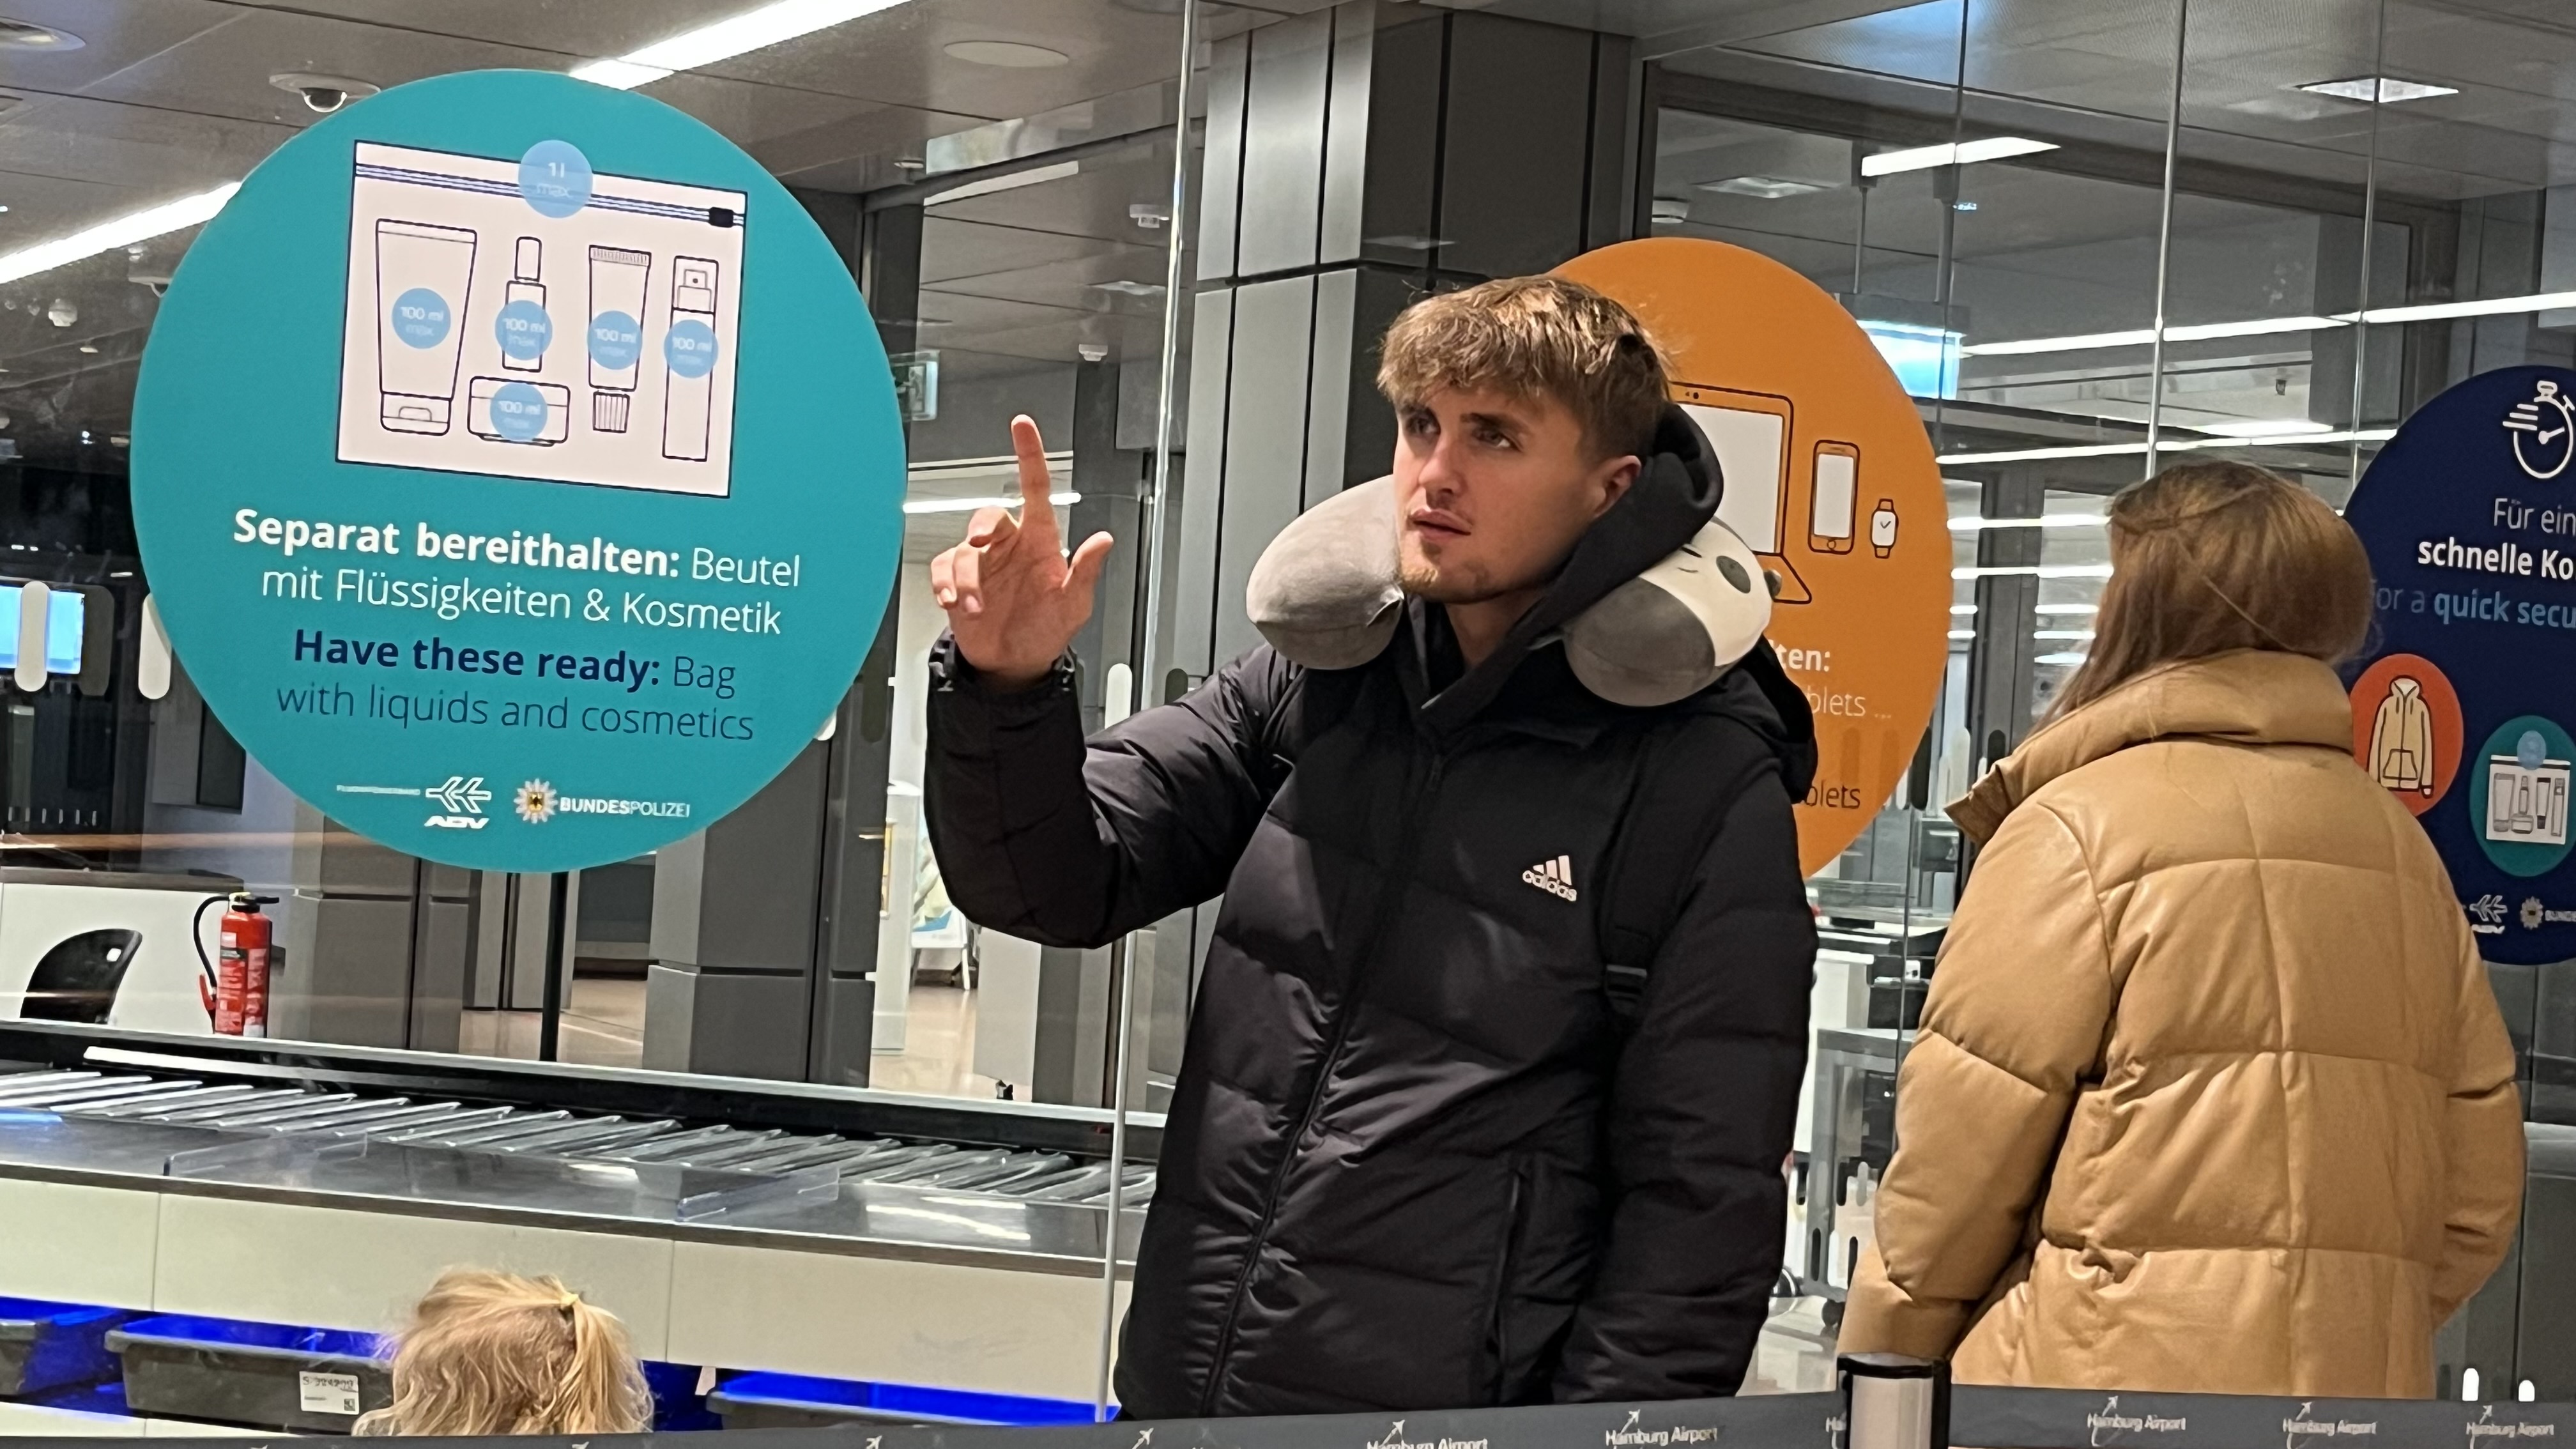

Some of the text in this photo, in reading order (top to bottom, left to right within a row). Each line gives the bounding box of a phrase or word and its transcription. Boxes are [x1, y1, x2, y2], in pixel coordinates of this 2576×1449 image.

[401, 306, 445, 321] 100 ml
[503, 318, 546, 334] 100 ml
[594, 328, 638, 344] 100 ml
[673, 337, 696, 350] 100
[498, 400, 523, 414] 100
[2494, 497, 2576, 537] Für ein
[233, 508, 801, 588] Separat bereithalten: Beutel
[2418, 536, 2576, 581] schnelle Ko
[262, 565, 782, 635] mit Flüssigkeiten & Kosmetik
[2411, 590, 2426, 614] a
[2434, 588, 2511, 625] quick
[2517, 601, 2576, 629] secu
[294, 628, 737, 700] Have these ready: Bag
[1768, 639, 1831, 672] ten:
[276, 680, 754, 740] with liquids and cosmetics
[560, 797, 691, 818] BUNDESPOLIZEI
[1522, 870, 1577, 902] adidas
[1605, 1429, 1669, 1447] Hamburg
